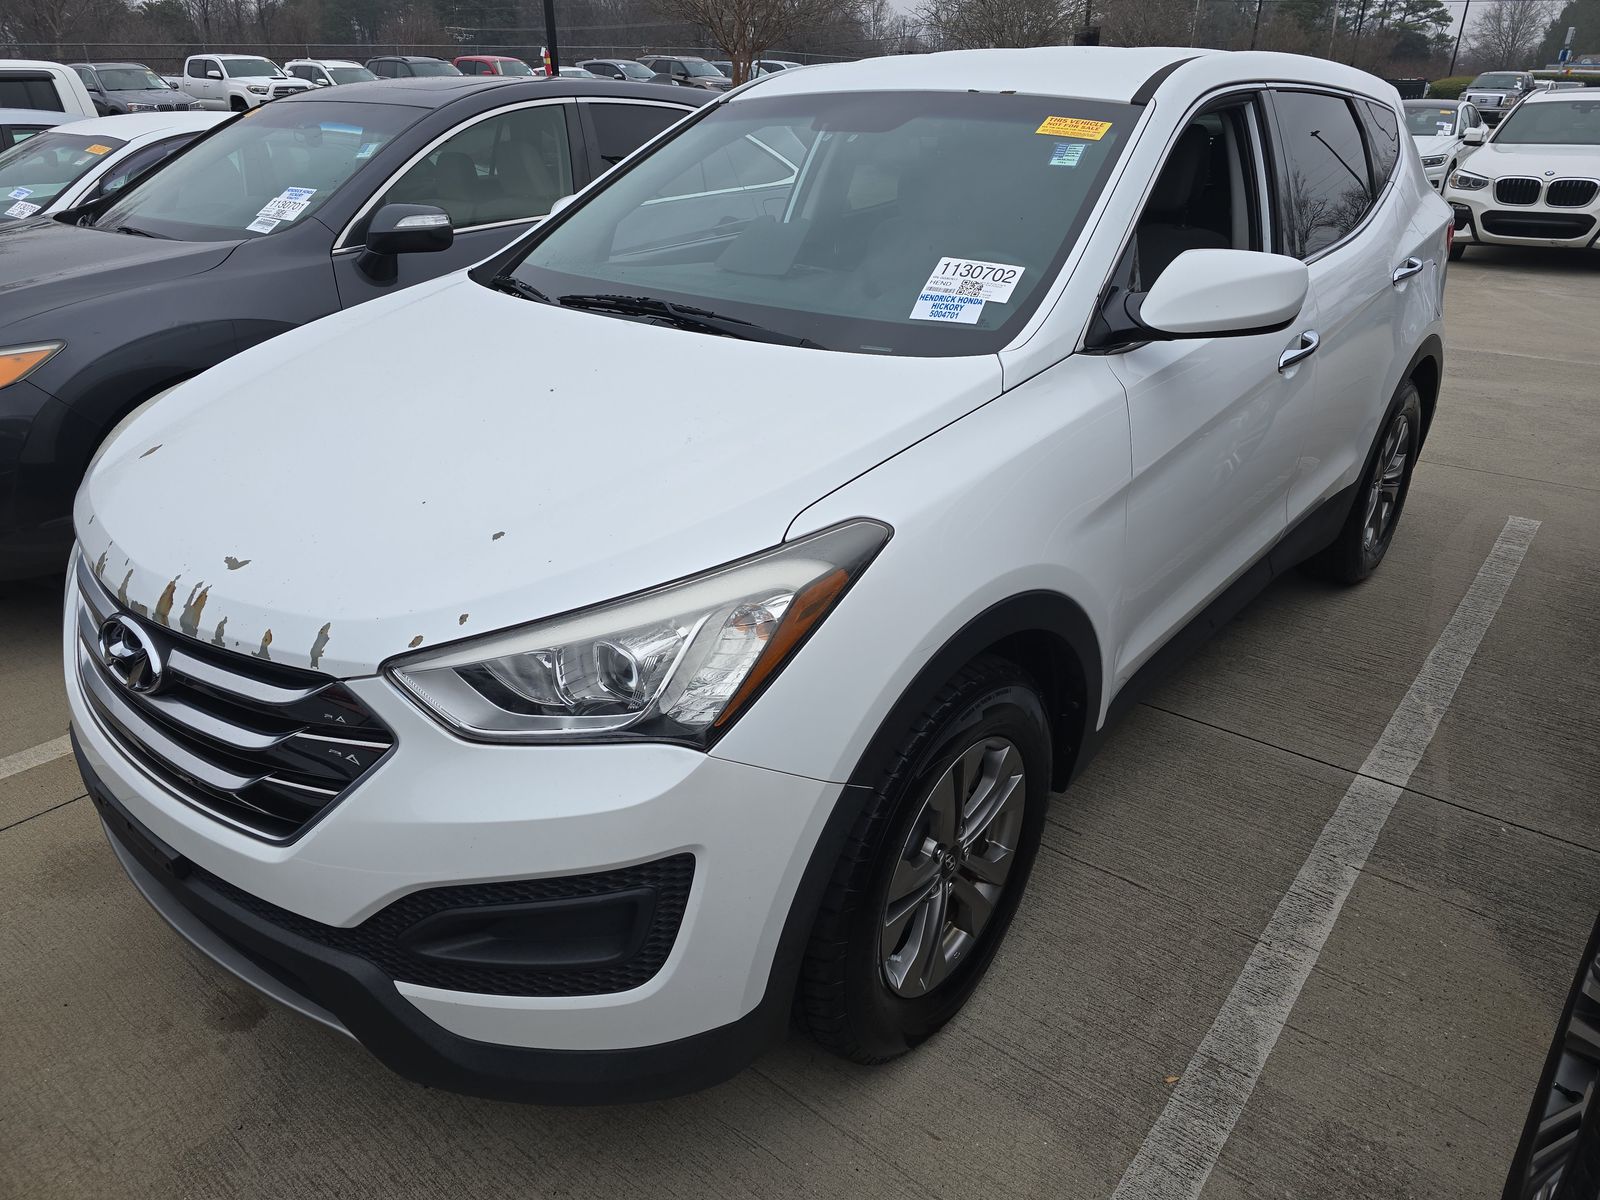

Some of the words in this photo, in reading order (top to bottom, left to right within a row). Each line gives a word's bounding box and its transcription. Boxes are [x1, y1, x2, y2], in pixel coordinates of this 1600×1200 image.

[1069, 119, 1106, 127] VEHICLE
[269, 200, 305, 211] 1130701
[942, 262, 1017, 284] 1130702
[920, 293, 957, 303] HENDRICK
[958, 297, 983, 305] HONDA
[931, 303, 965, 311] HICKORY
[929, 310, 959, 319] 5004701
